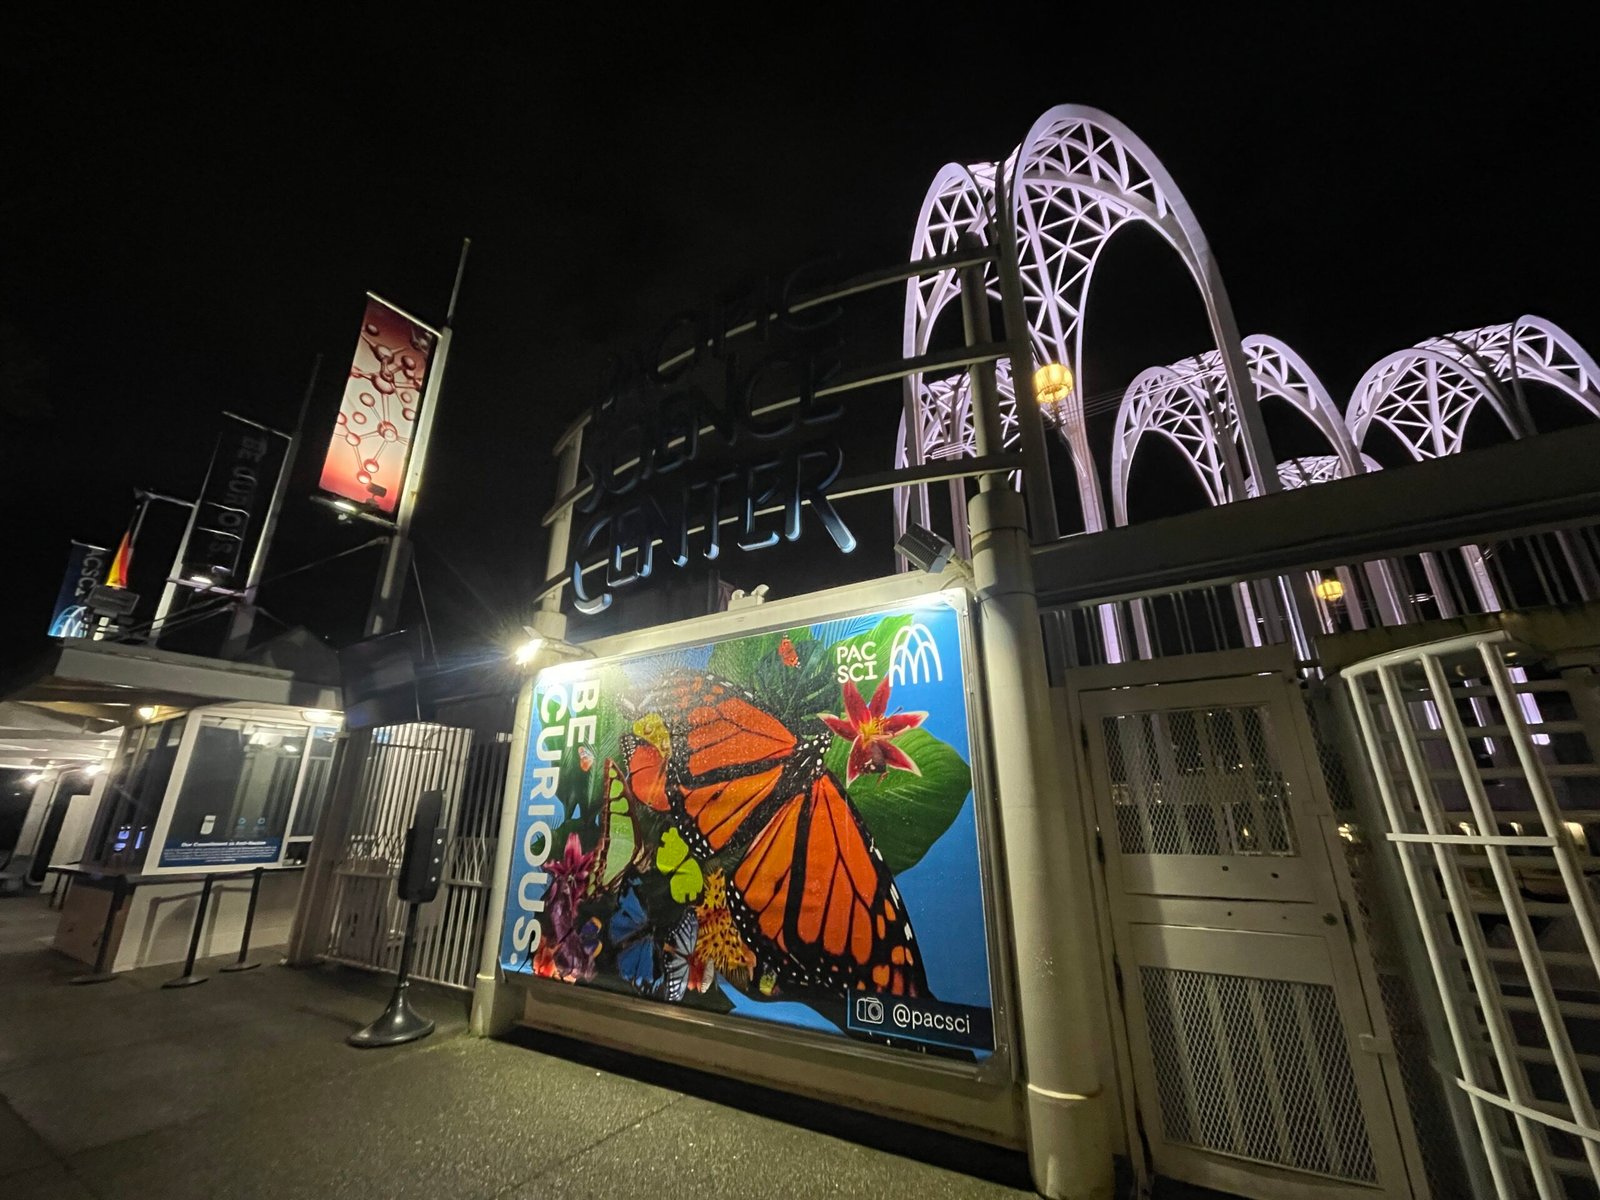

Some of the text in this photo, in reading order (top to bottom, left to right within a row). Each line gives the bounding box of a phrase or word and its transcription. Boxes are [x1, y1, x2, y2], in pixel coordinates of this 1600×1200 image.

[208, 466, 258, 554] CUROUS
[573, 440, 857, 615] CENTER
[836, 641, 877, 665] PAC
[837, 660, 878, 684] SCI
[567, 679, 601, 748] BE
[510, 682, 568, 965] CURIOUS.
[892, 1003, 971, 1034] @pacsci
